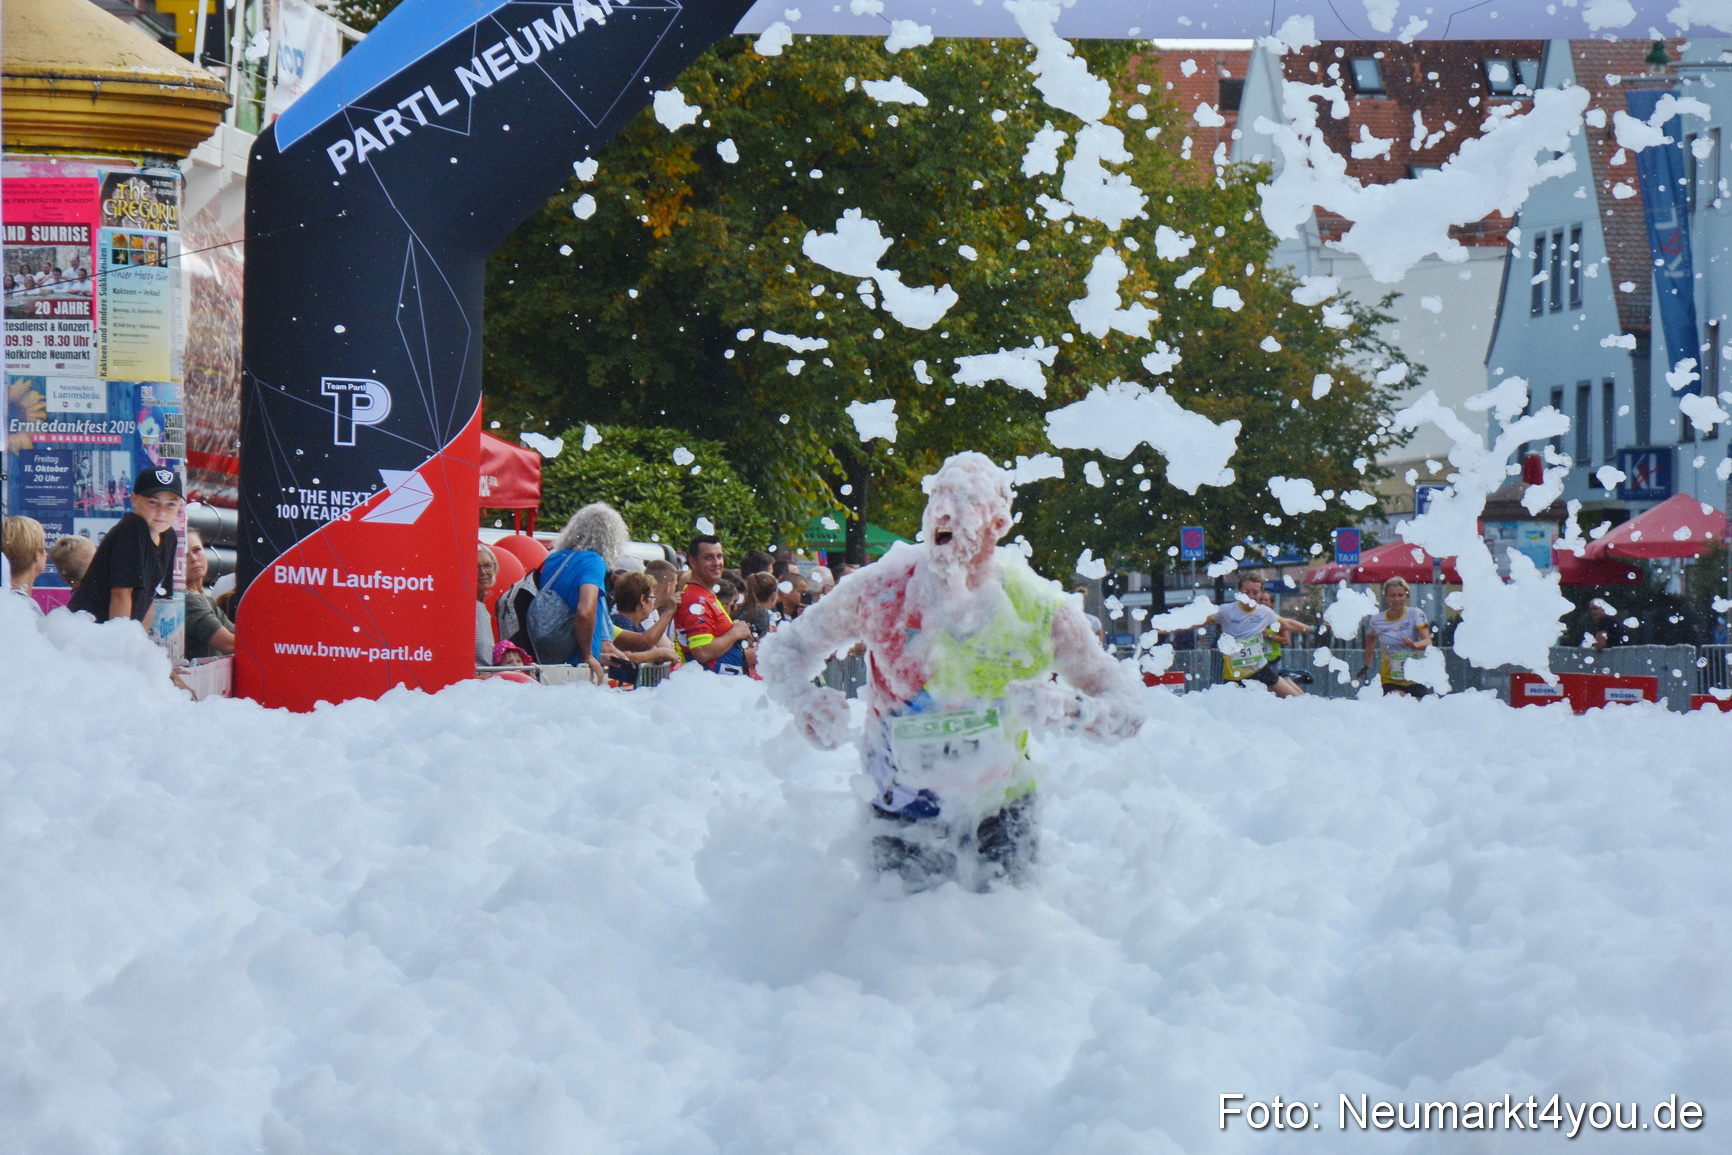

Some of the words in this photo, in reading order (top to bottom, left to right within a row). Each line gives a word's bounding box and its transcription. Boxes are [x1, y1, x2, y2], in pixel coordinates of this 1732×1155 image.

[327, 84, 459, 175] PARTL
[454, 0, 631, 97] NEUMA
[31, 226, 89, 242] SUNRISE
[35, 301, 50, 314] 20
[54, 302, 90, 315] JAHRE
[99, 298, 107, 323] andere
[4, 321, 48, 332] tesdienst
[50, 323, 55, 332] &
[58, 322, 90, 332] Konzert
[43, 335, 70, 347] 18.30
[73, 335, 90, 347] Uhr
[99, 327, 107, 342] und
[5, 349, 47, 359] Hofkirche
[50, 350, 90, 360] Neumarkt
[99, 345, 107, 377] Kakteen
[326, 382, 347, 390] Team
[53, 390, 101, 400] Lammsbräu
[9, 419, 107, 434] Erntedankfest
[109, 420, 136, 434] 2019
[51, 435, 119, 443] BRAUEREIHOF
[33, 455, 59, 464] Freitag
[35, 465, 69, 473] Oktober
[298, 488, 325, 505] THE
[330, 490, 371, 507] NEXT
[276, 504, 299, 520] 100
[302, 506, 352, 522] YEARS
[1337, 553, 1358, 562] TAXI
[274, 565, 326, 586] BMW
[333, 569, 434, 593] Laufsport
[274, 642, 433, 662] www.bmw-partl.de
[1240, 648, 1252, 657] 51
